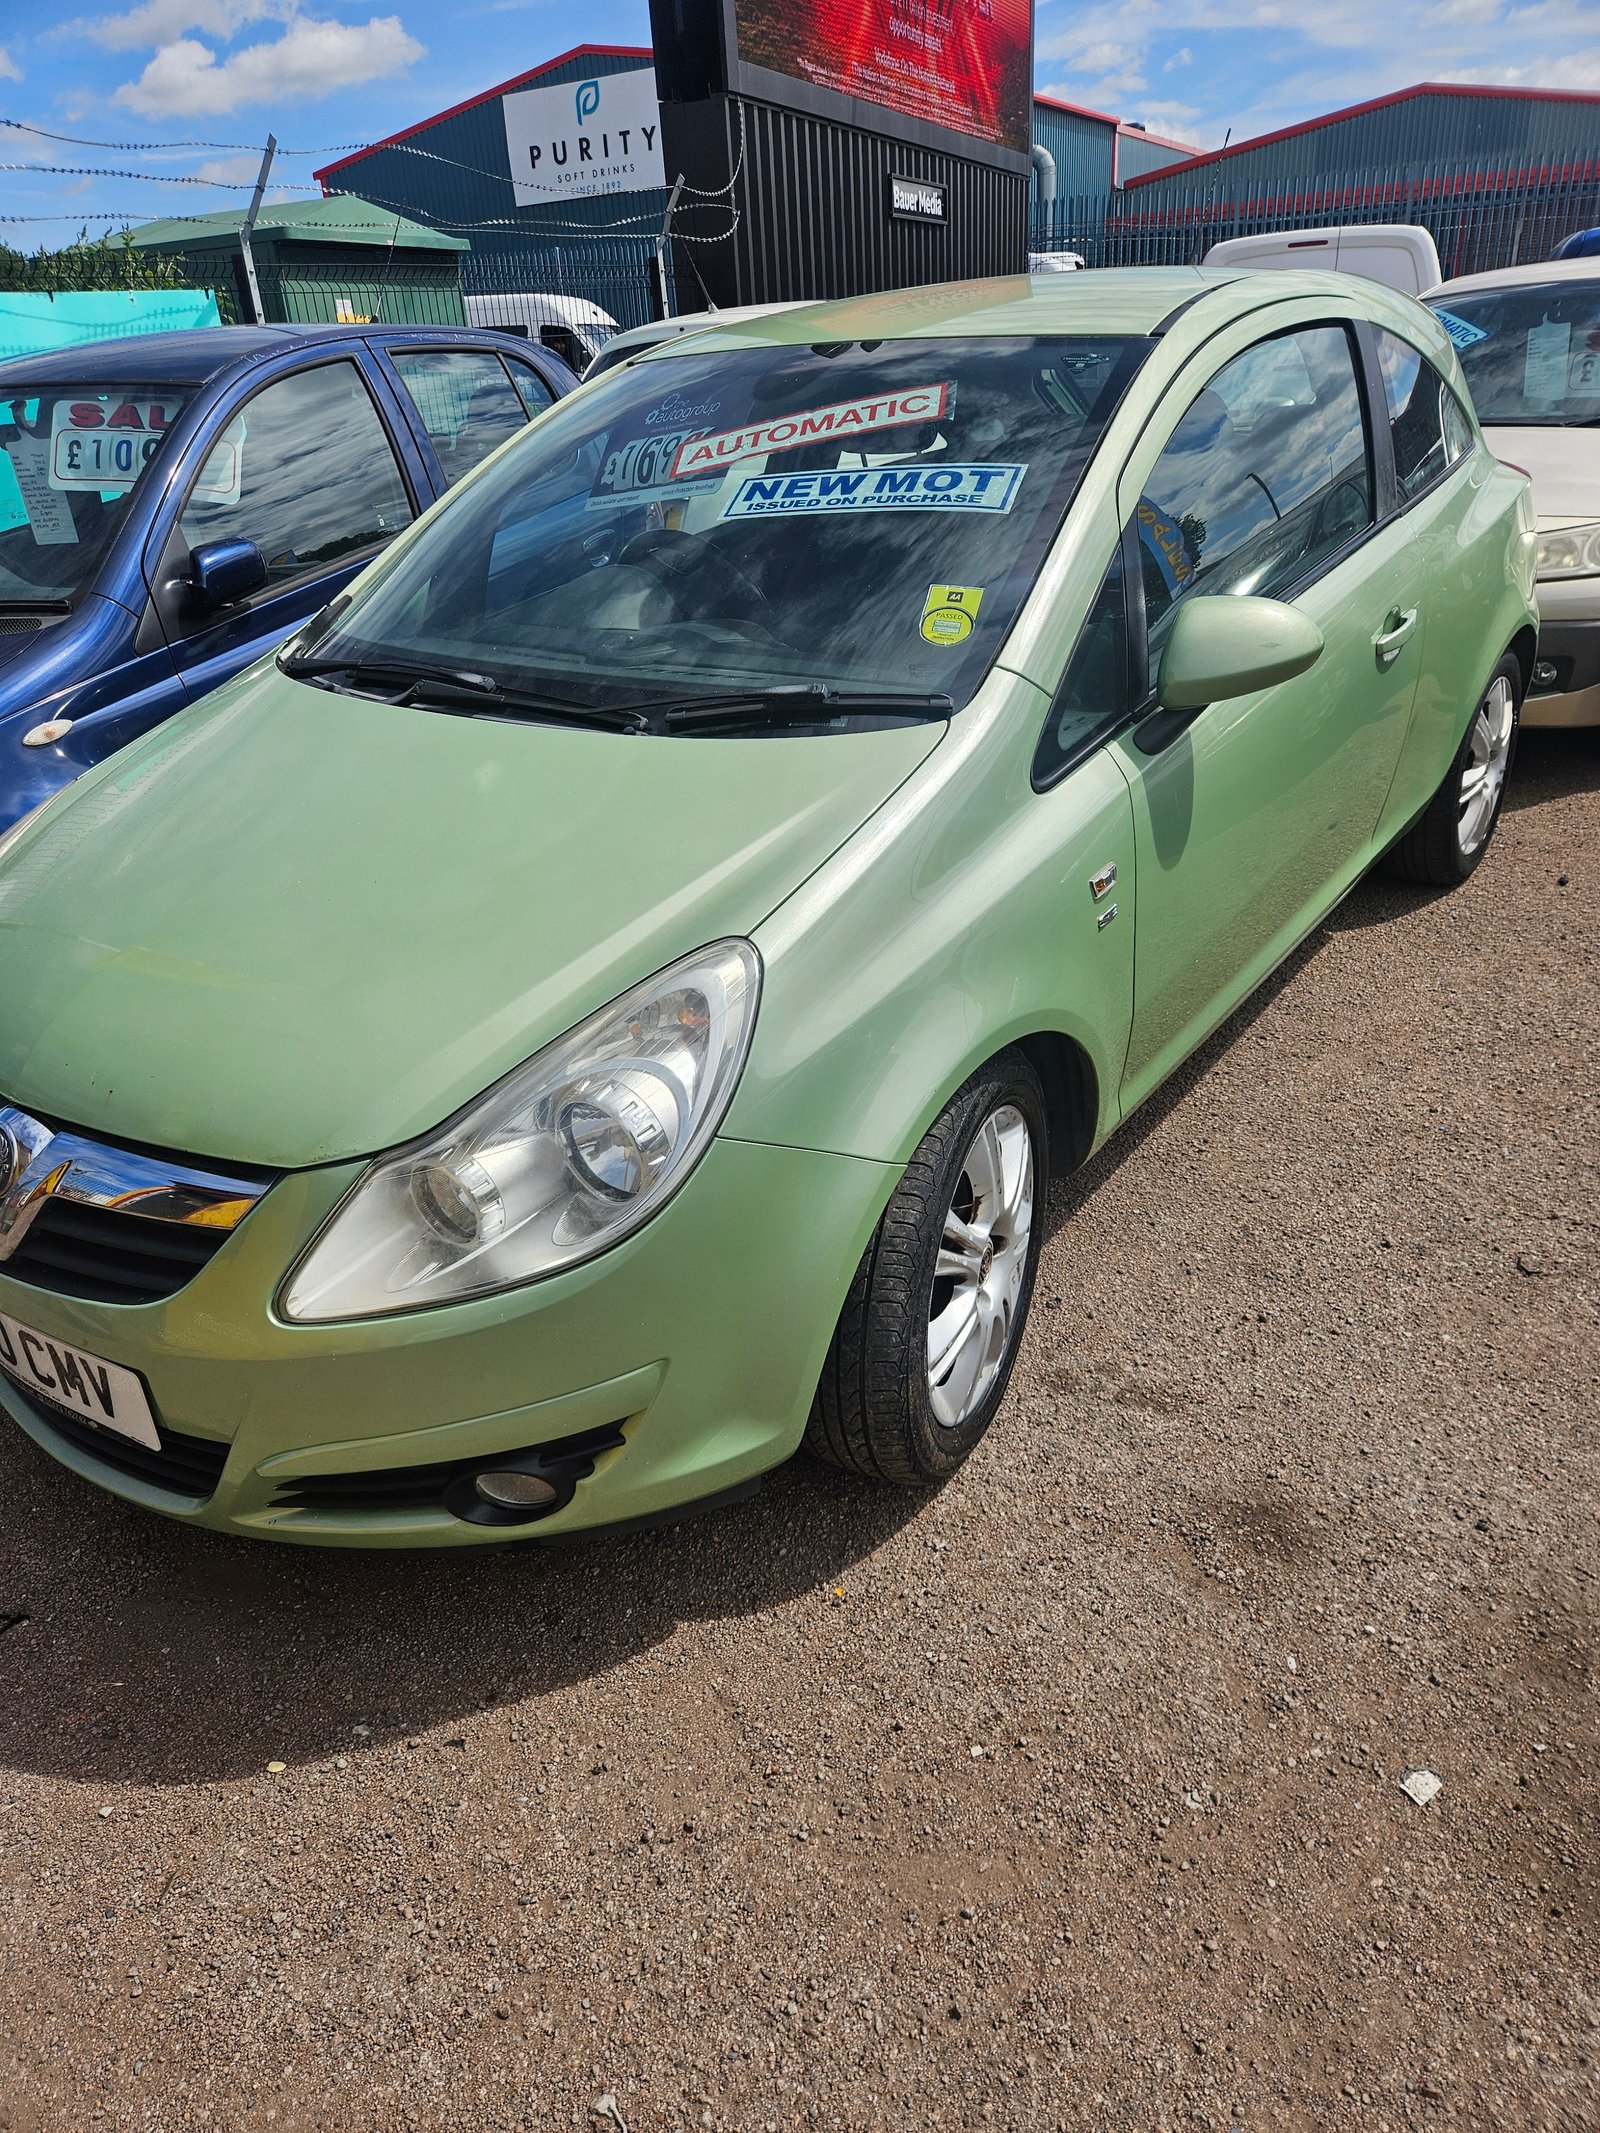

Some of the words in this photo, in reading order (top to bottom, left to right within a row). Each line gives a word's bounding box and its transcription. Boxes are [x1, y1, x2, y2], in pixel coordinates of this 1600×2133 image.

[529, 126, 656, 169] PURITY
[557, 171, 585, 183] SOFT
[592, 163, 635, 178] DRINKS
[601, 181, 621, 191] 1892
[893, 185, 917, 212] Bauer
[919, 190, 942, 216] Media
[68, 402, 171, 431] SAL
[655, 402, 721, 422] autogroup
[687, 394, 930, 465] AUTOMATIC
[607, 431, 704, 483] £169
[742, 473, 867, 501] NEW
[874, 470, 1005, 493] MOT
[747, 499, 820, 511] ISSUED
[826, 496, 860, 505] ON
[863, 494, 983, 505] PURCHASE
[1137, 503, 1190, 583] SALES
[949, 592, 961, 601] AA
[936, 612, 963, 621] PASSED
